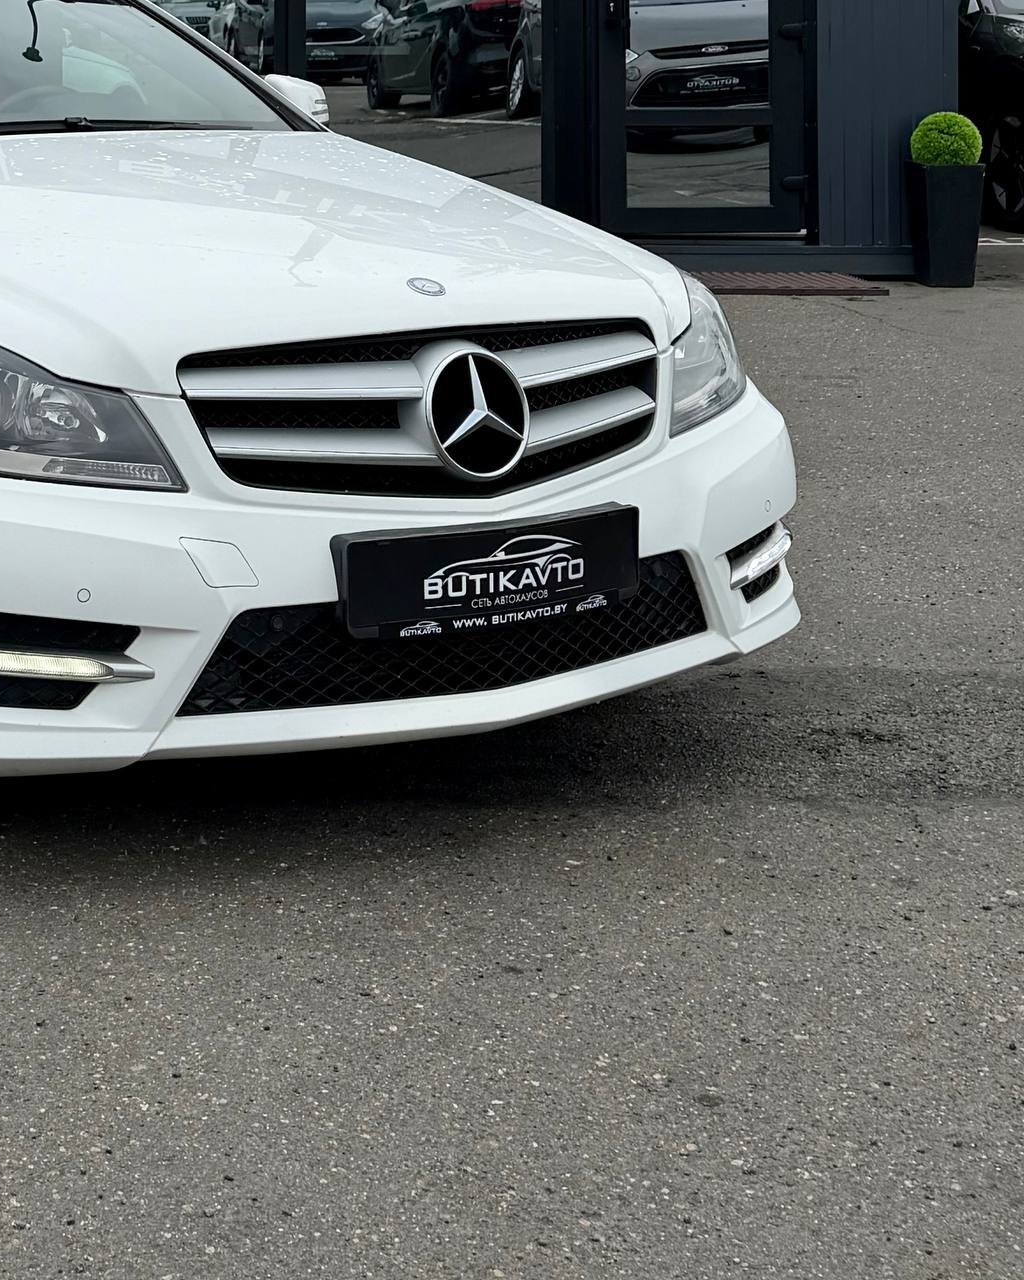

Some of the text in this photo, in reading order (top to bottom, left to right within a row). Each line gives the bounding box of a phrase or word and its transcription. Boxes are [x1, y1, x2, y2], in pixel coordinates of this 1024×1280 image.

[423, 558, 584, 600] BUTIKAVTO
[470, 589, 549, 609] СЕТЬ АВТОХАУСОВ
[452, 603, 568, 629] WWW. BUTIKAVTO.BY
